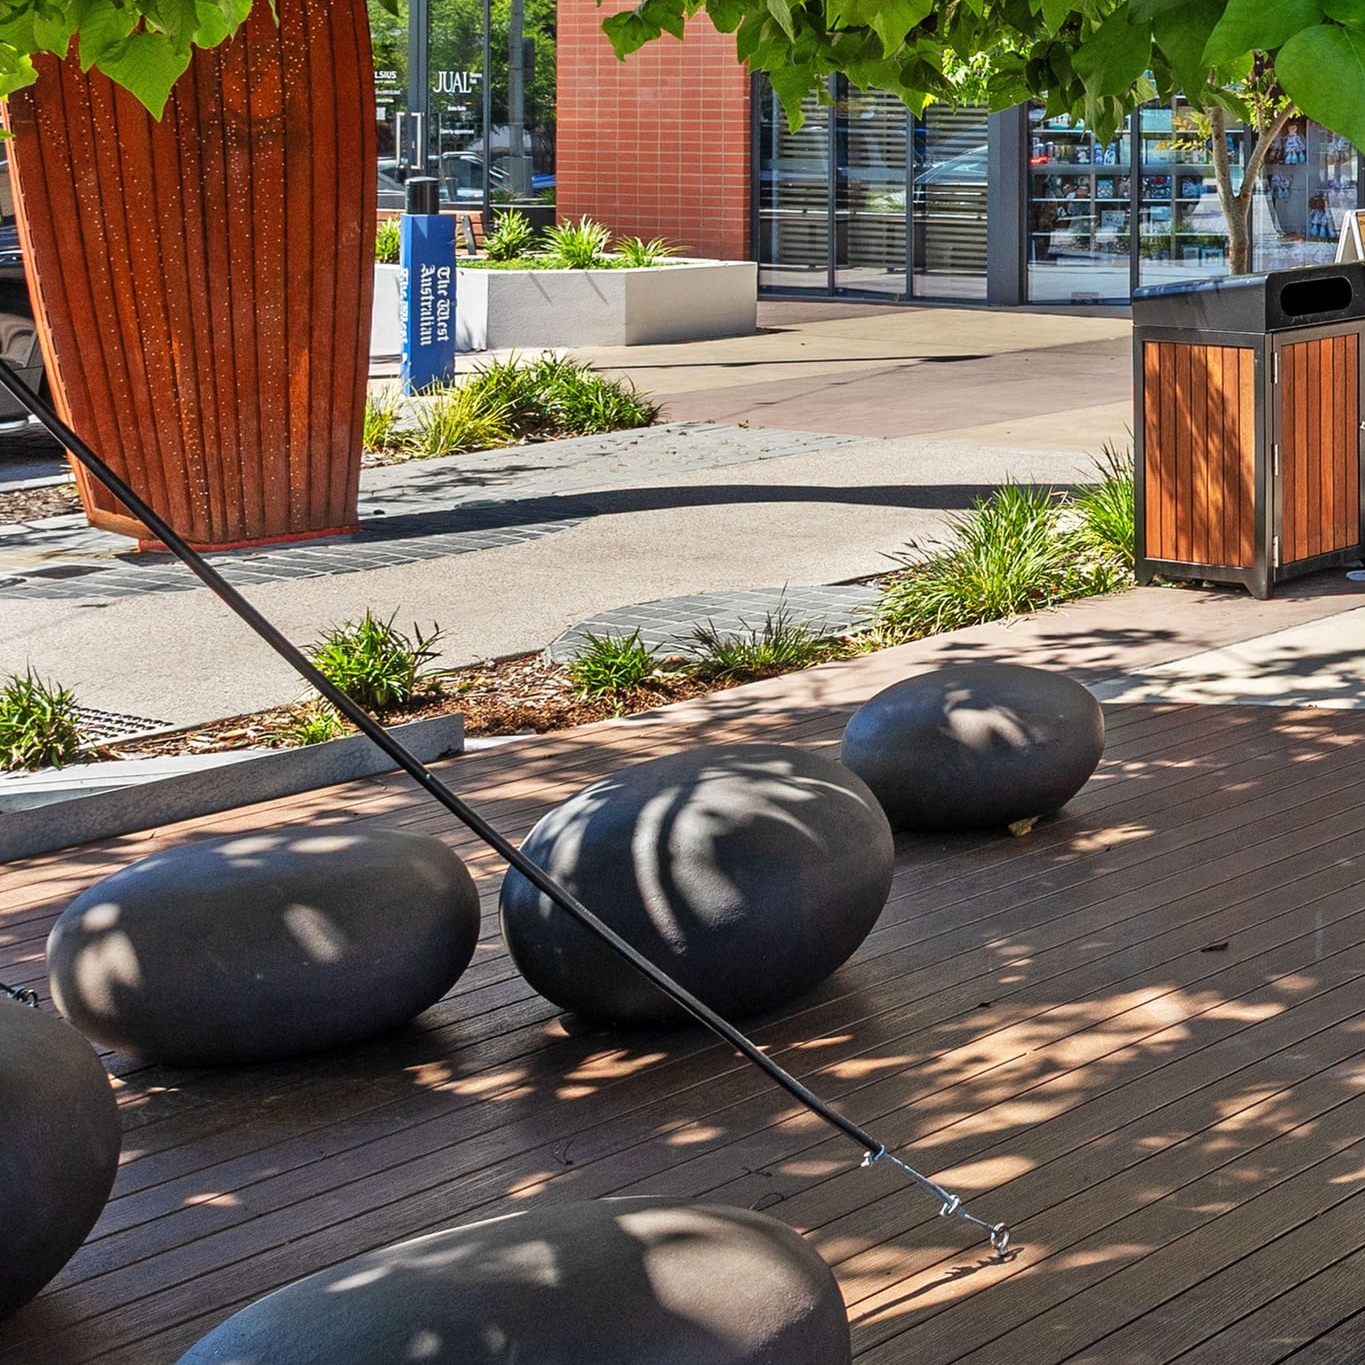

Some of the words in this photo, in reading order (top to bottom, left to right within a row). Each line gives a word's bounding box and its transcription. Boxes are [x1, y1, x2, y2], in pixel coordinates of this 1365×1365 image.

[374, 70, 397, 79] LSIUS
[432, 71, 472, 93] JUAL
[437, 265, 451, 297] The
[420, 263, 436, 347] Australian
[436, 298, 450, 342] West
